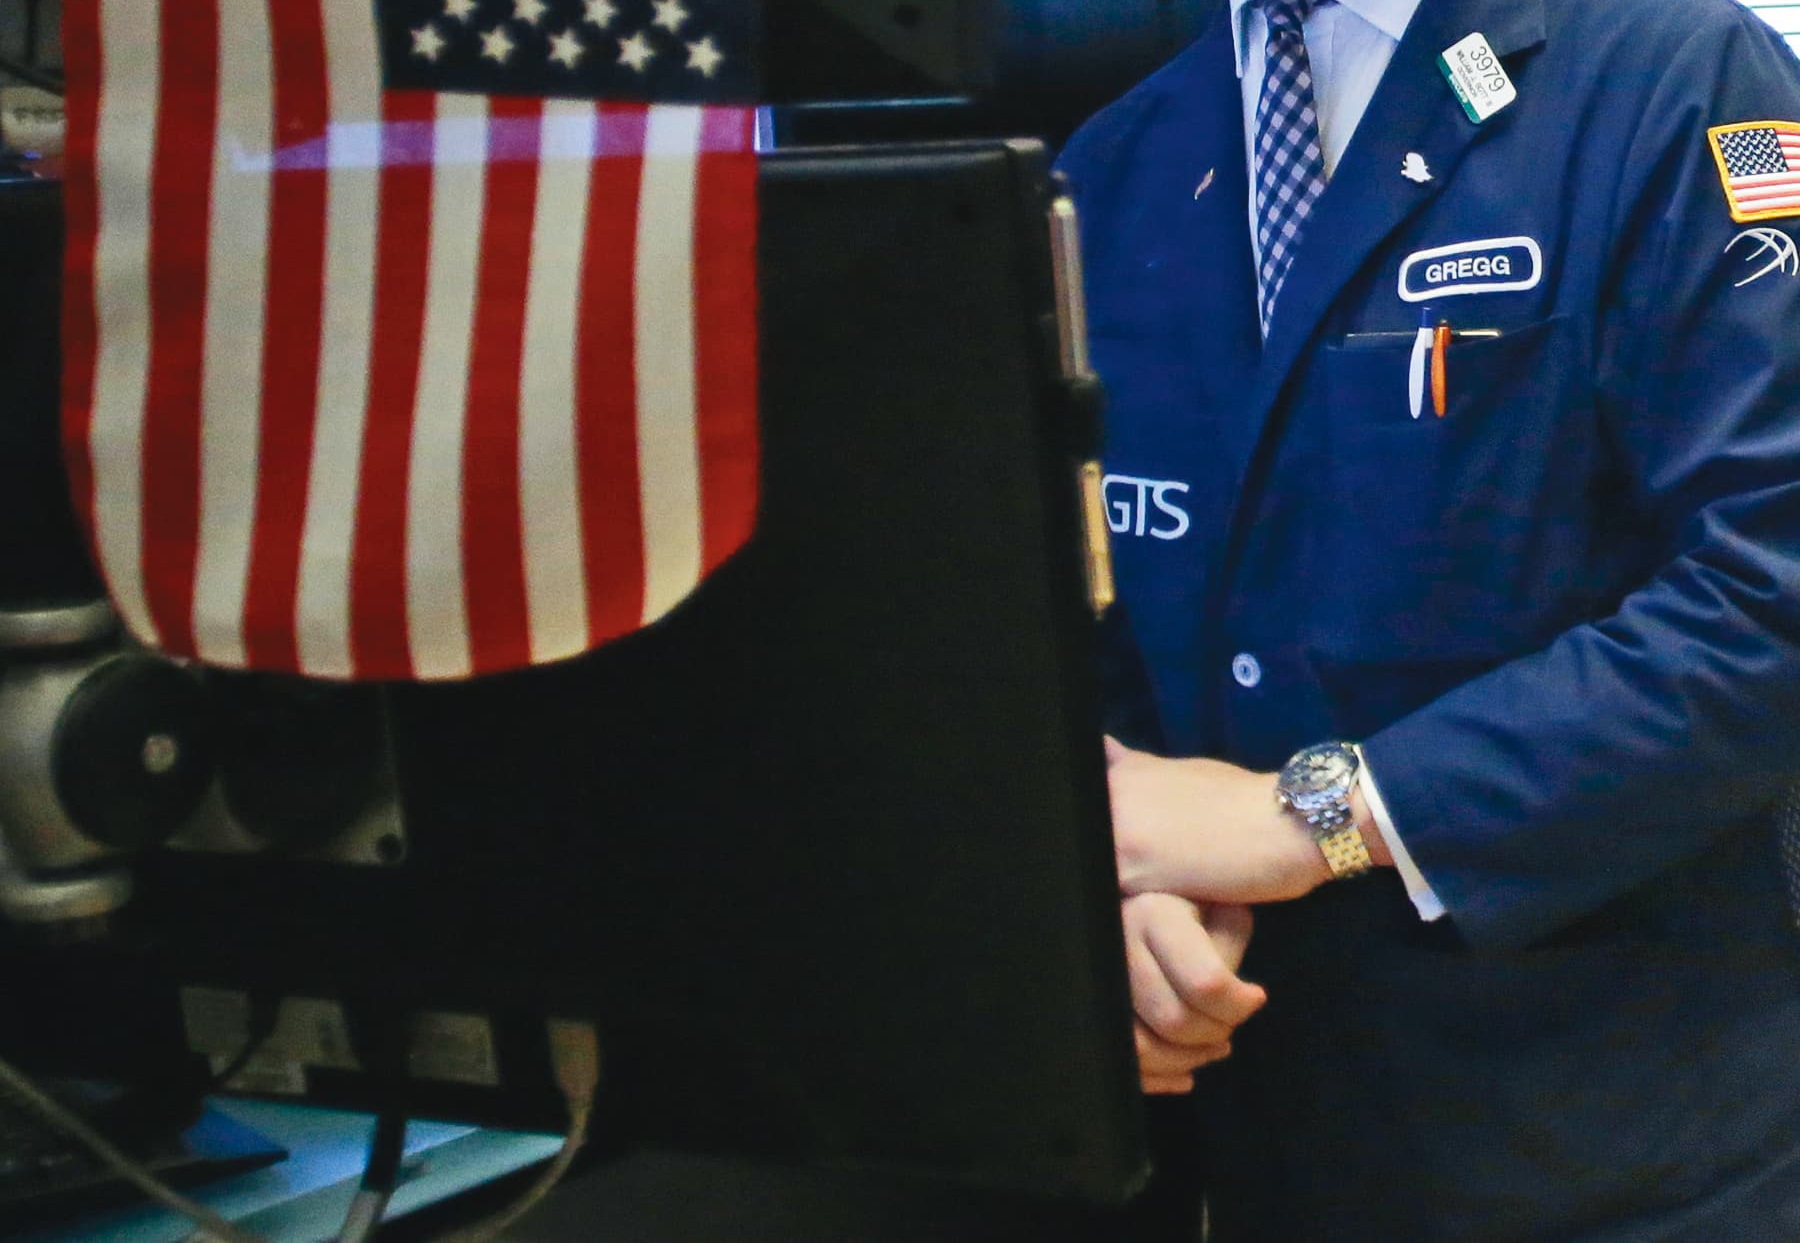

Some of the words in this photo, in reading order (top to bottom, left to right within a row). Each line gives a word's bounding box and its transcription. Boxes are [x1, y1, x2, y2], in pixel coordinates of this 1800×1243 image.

[1470, 45, 1505, 92] 3979
[1425, 255, 1511, 283] GREGG
[1101, 473, 1190, 540] GTS
